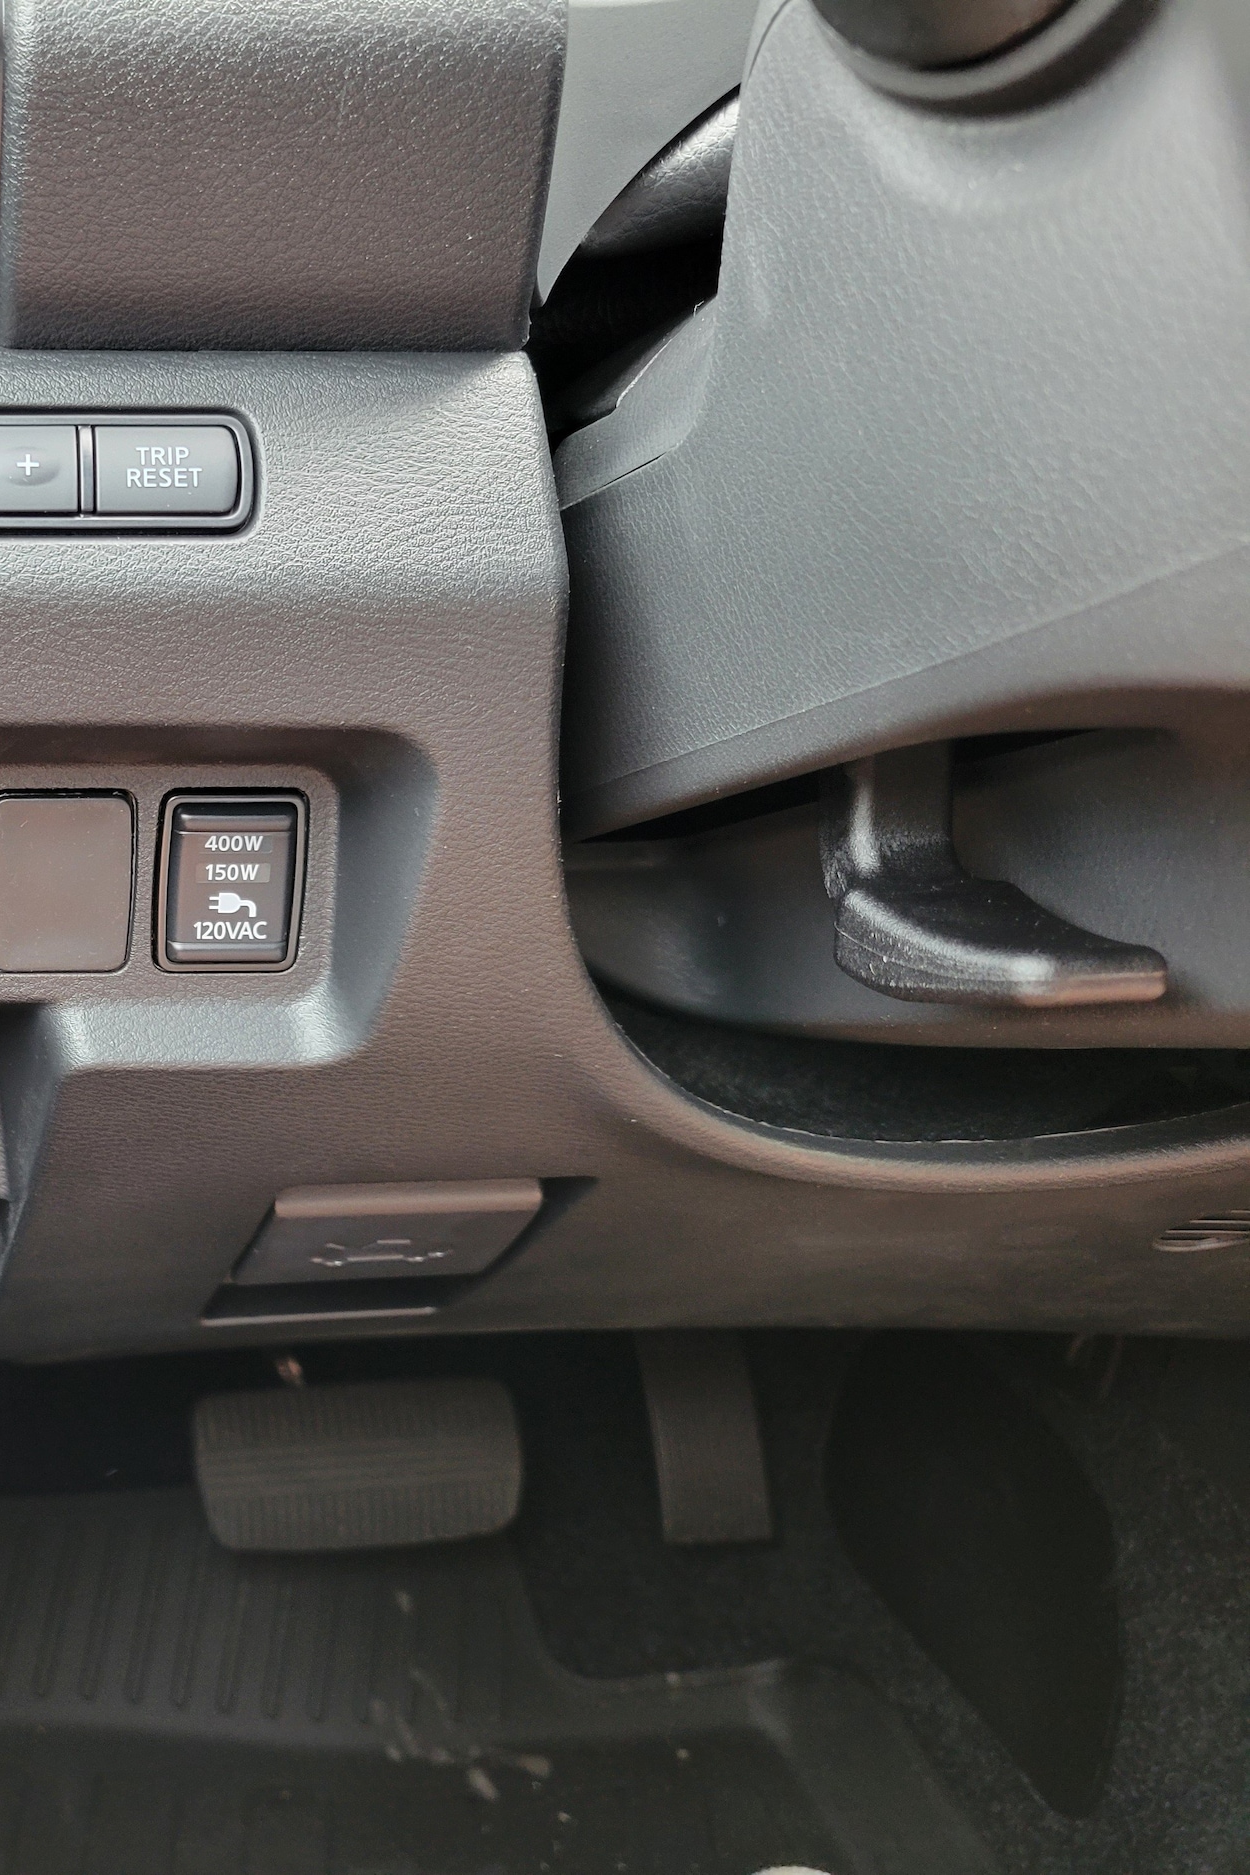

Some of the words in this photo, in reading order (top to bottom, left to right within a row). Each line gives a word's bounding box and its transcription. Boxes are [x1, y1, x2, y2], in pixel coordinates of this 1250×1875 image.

[135, 446, 189, 466] TRIP
[126, 467, 203, 488] RESET
[204, 835, 264, 852] 400W
[205, 863, 260, 881] 150W
[193, 920, 267, 940] 120VAC
